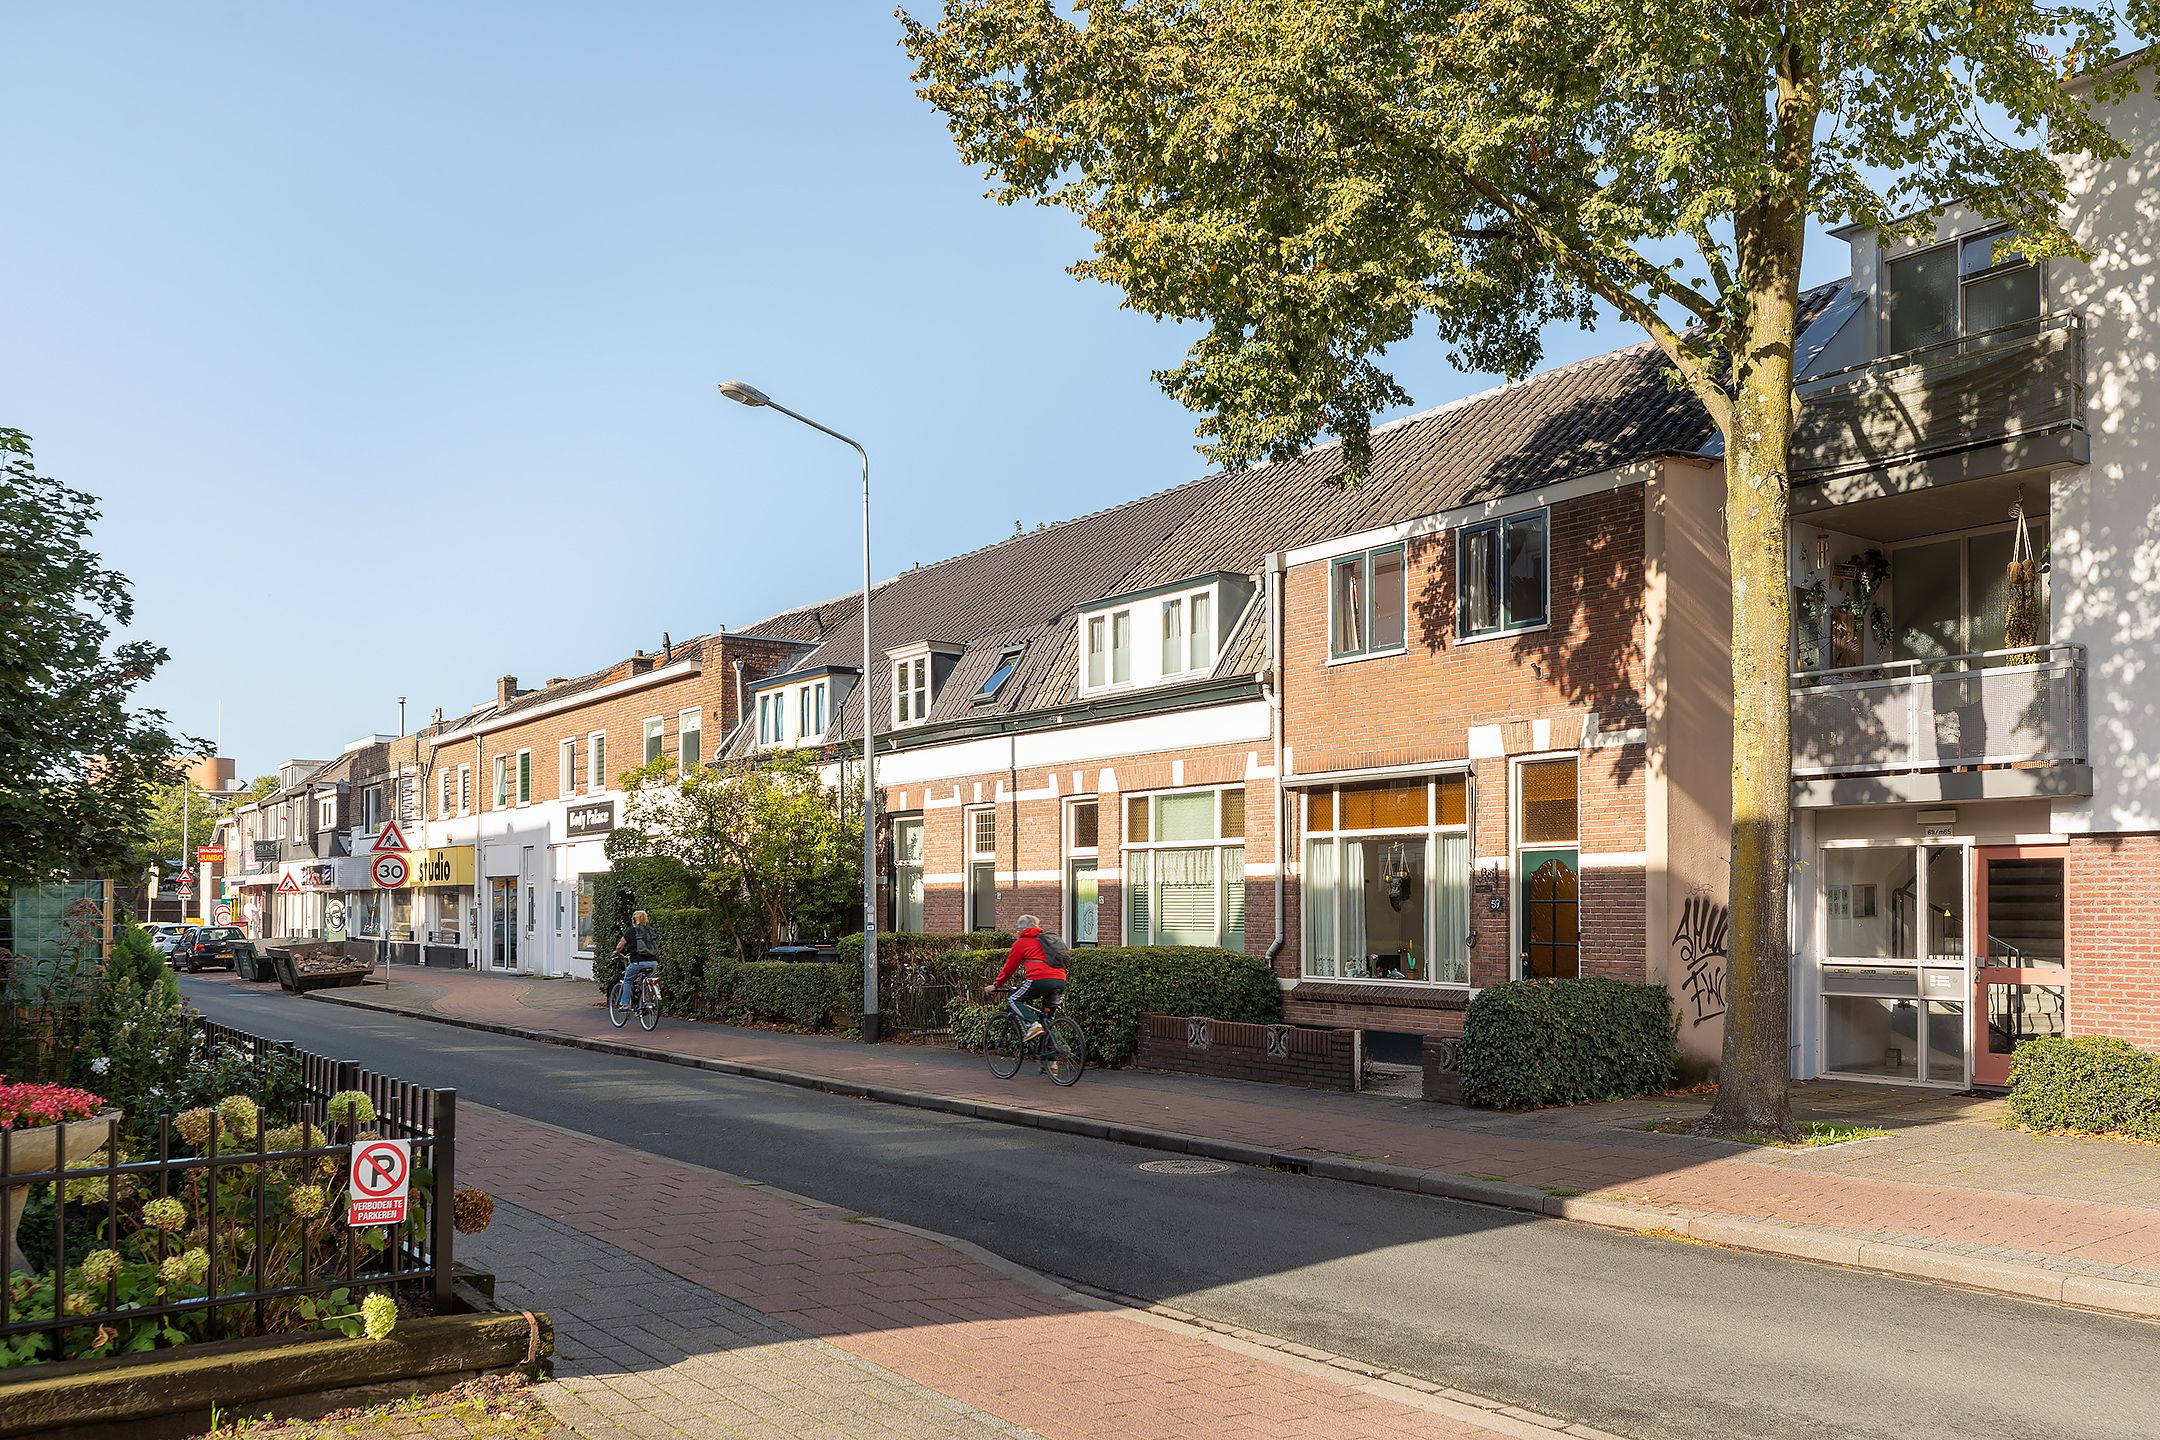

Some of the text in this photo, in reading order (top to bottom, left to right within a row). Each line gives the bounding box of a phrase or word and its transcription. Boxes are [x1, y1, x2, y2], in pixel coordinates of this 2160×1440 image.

[569, 809, 609, 830] Body Palace
[378, 864, 403, 878] 30
[419, 852, 451, 882] studio
[1490, 898, 1500, 909] 59
[371, 1155, 395, 1188] P
[352, 1199, 404, 1211] VERBODEN TE
[357, 1210, 397, 1221] PARKEREN
